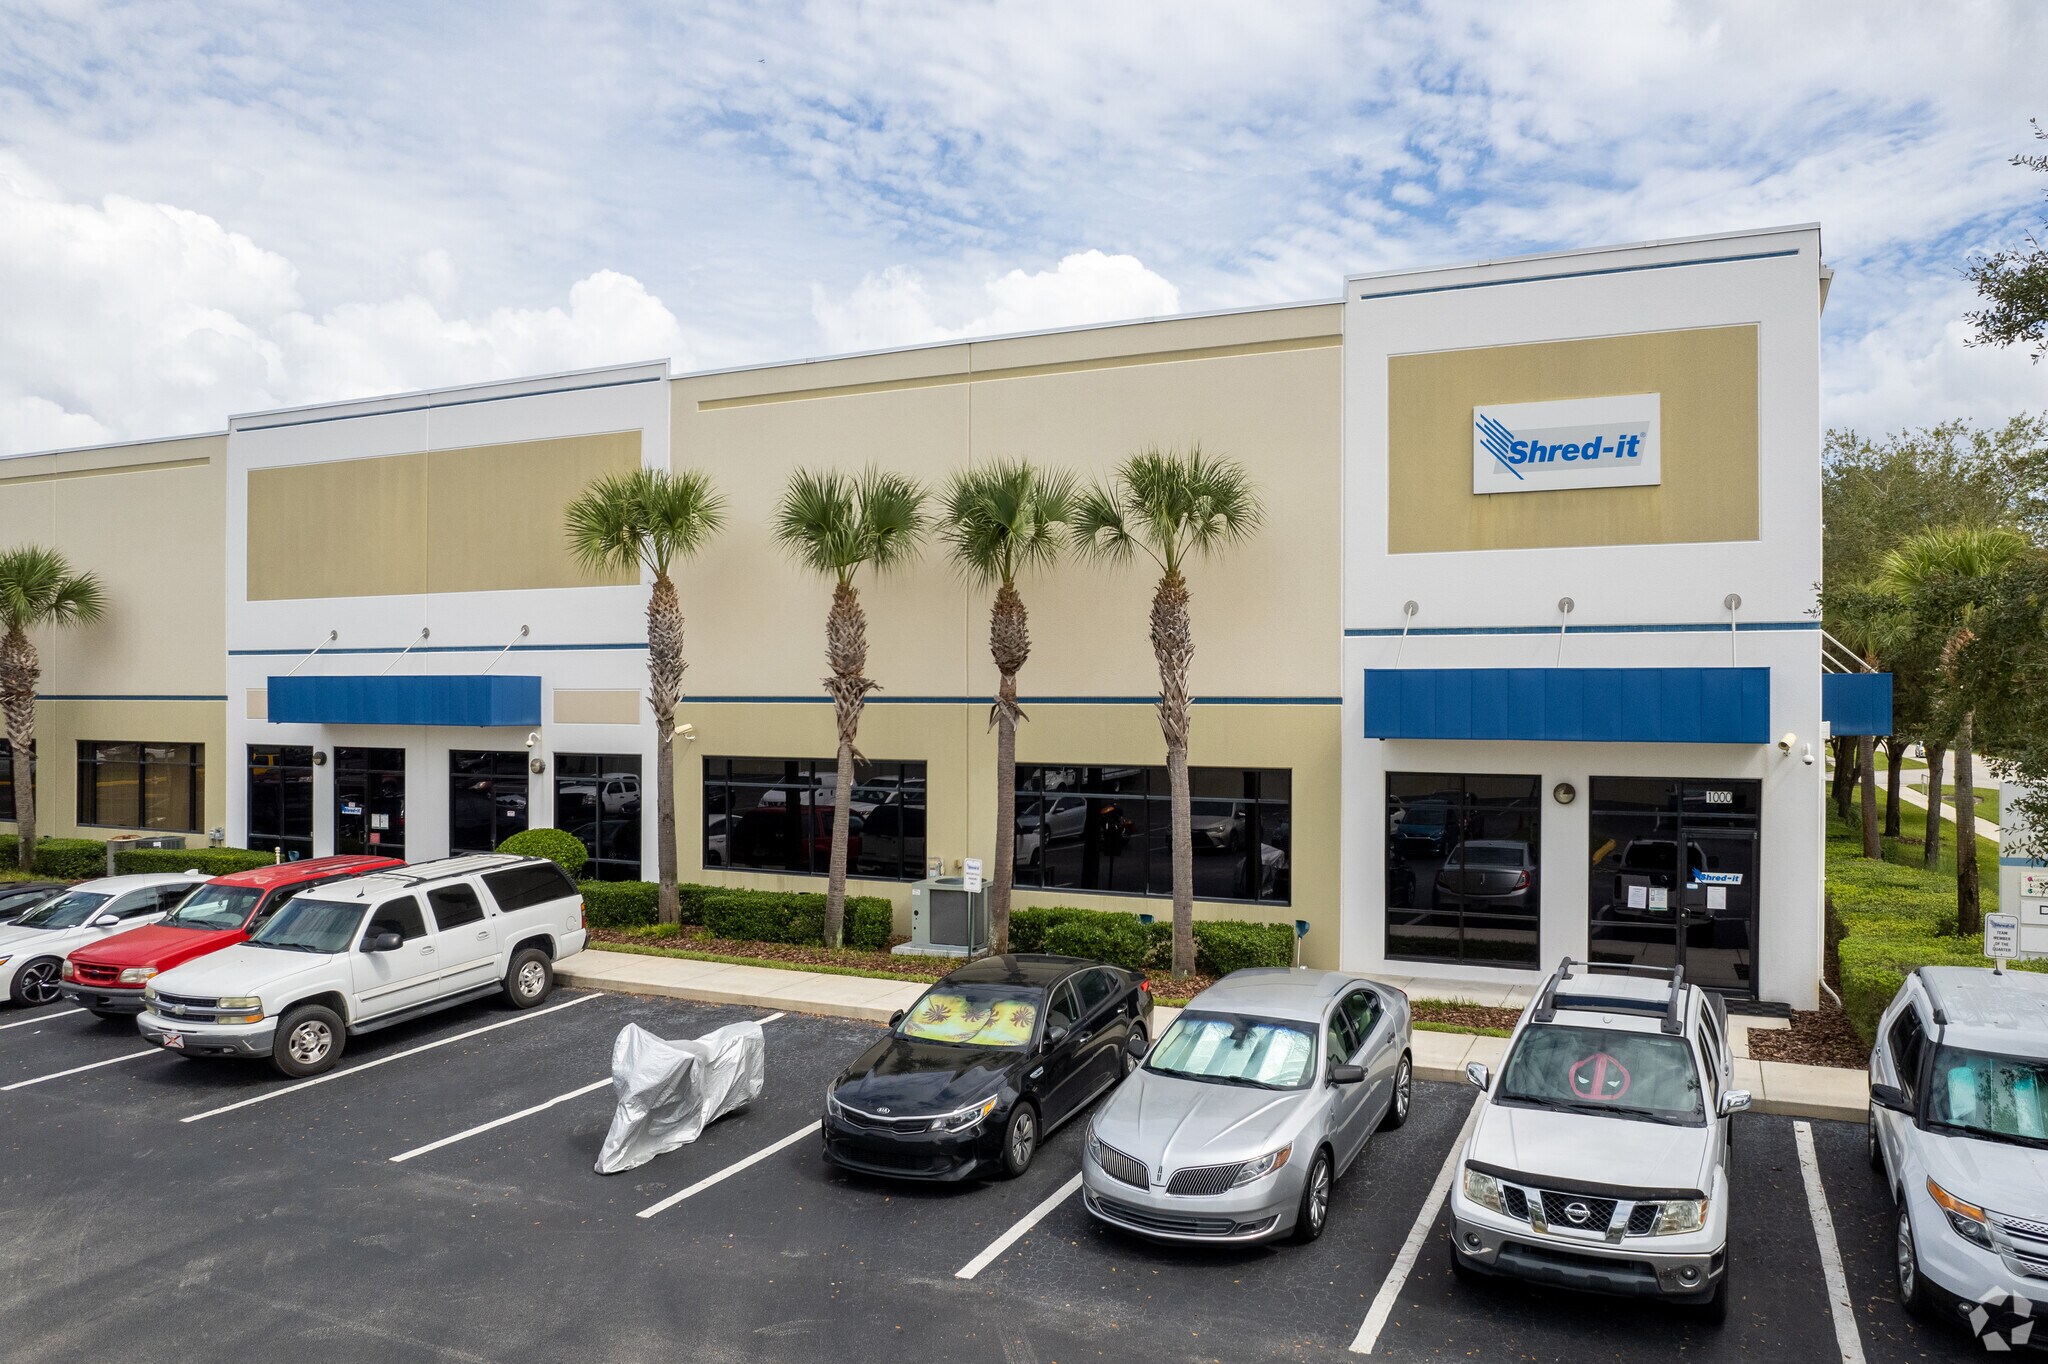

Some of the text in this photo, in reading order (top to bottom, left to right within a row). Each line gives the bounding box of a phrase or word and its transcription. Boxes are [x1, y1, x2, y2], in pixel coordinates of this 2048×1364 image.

[1508, 434, 1640, 465] Shred-it
[1708, 791, 1732, 803] 1000
[1700, 873, 1739, 882] Shred-it
